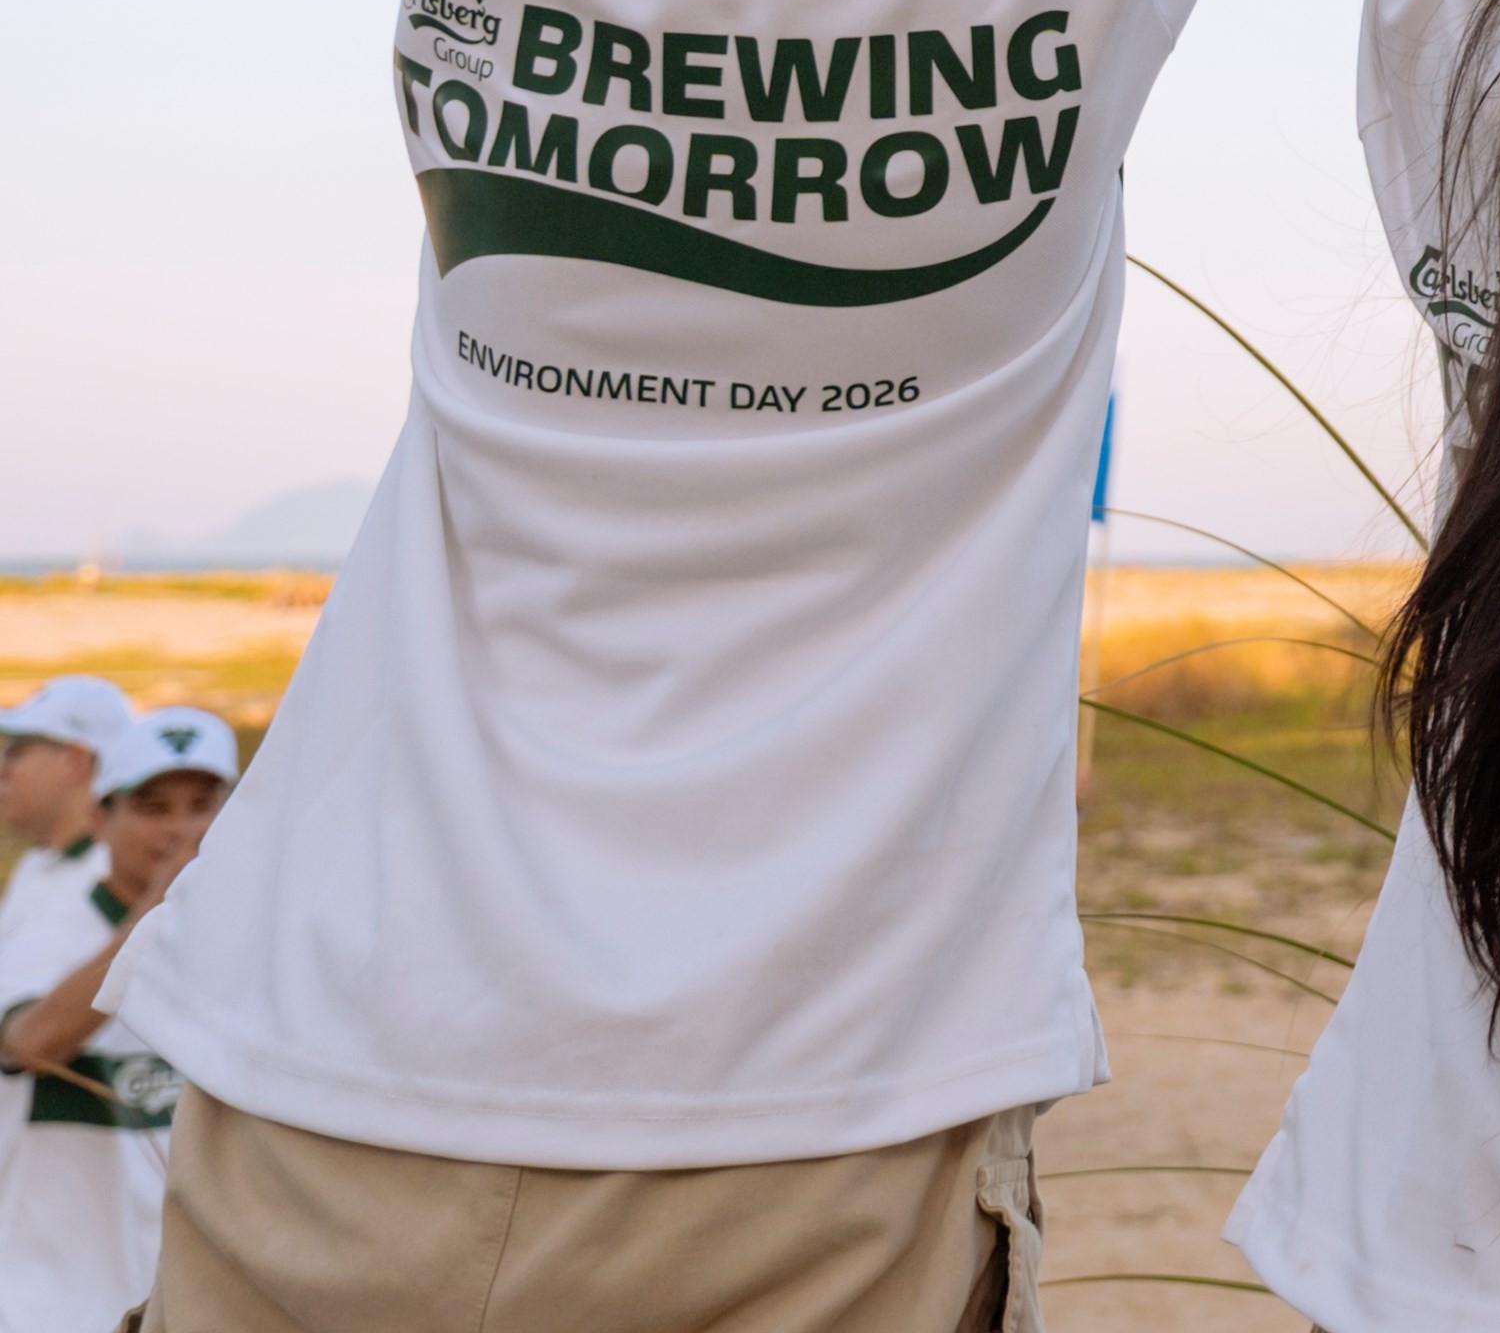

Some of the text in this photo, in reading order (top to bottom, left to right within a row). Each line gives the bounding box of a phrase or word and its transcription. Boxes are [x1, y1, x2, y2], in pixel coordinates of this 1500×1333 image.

[434, 36, 494, 82] Group
[512, 3, 1082, 123] BREWING
[393, 45, 1081, 223] TOMORROW
[458, 331, 920, 413] ENVIRONMENT DAY 2026
